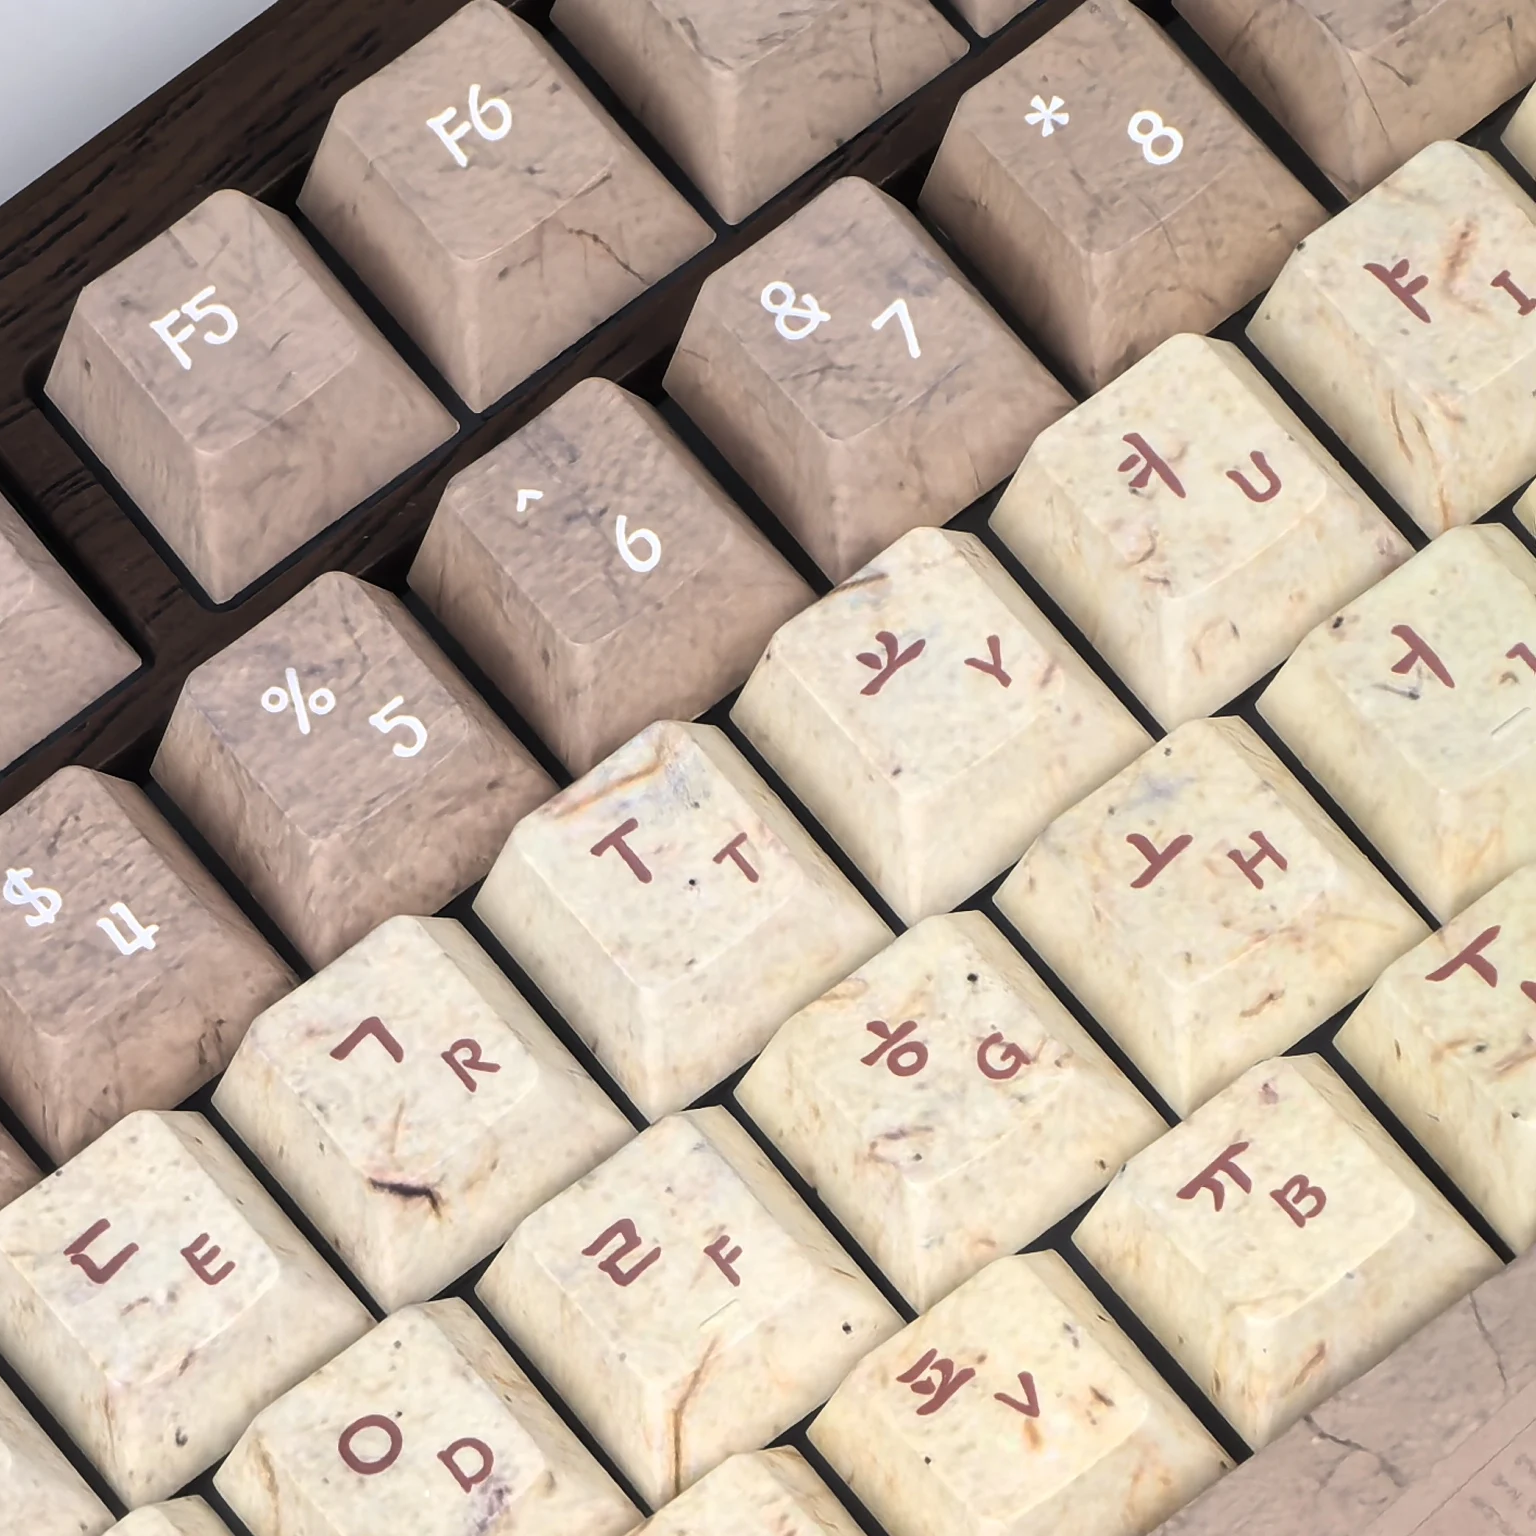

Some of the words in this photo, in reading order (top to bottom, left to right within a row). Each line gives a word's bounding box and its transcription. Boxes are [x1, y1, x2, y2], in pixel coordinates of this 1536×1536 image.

[425, 83, 513, 168] F6
[1127, 110, 1184, 166] 8
[149, 285, 239, 371] F5
[870, 297, 922, 359] 7
[1227, 452, 1282, 503] U
[615, 514, 662, 573] 6
[966, 636, 1012, 688] Y
[368, 695, 428, 758] 5
[714, 833, 758, 883] T
[1228, 831, 1288, 889] H
[95, 901, 160, 956] 4
[442, 1039, 501, 1093] R
[977, 1033, 1032, 1080] G
[1270, 1175, 1327, 1228] B
[180, 1235, 236, 1286] E
[704, 1236, 742, 1286] F
[993, 1372, 1040, 1418] V
[438, 1439, 494, 1493] D
